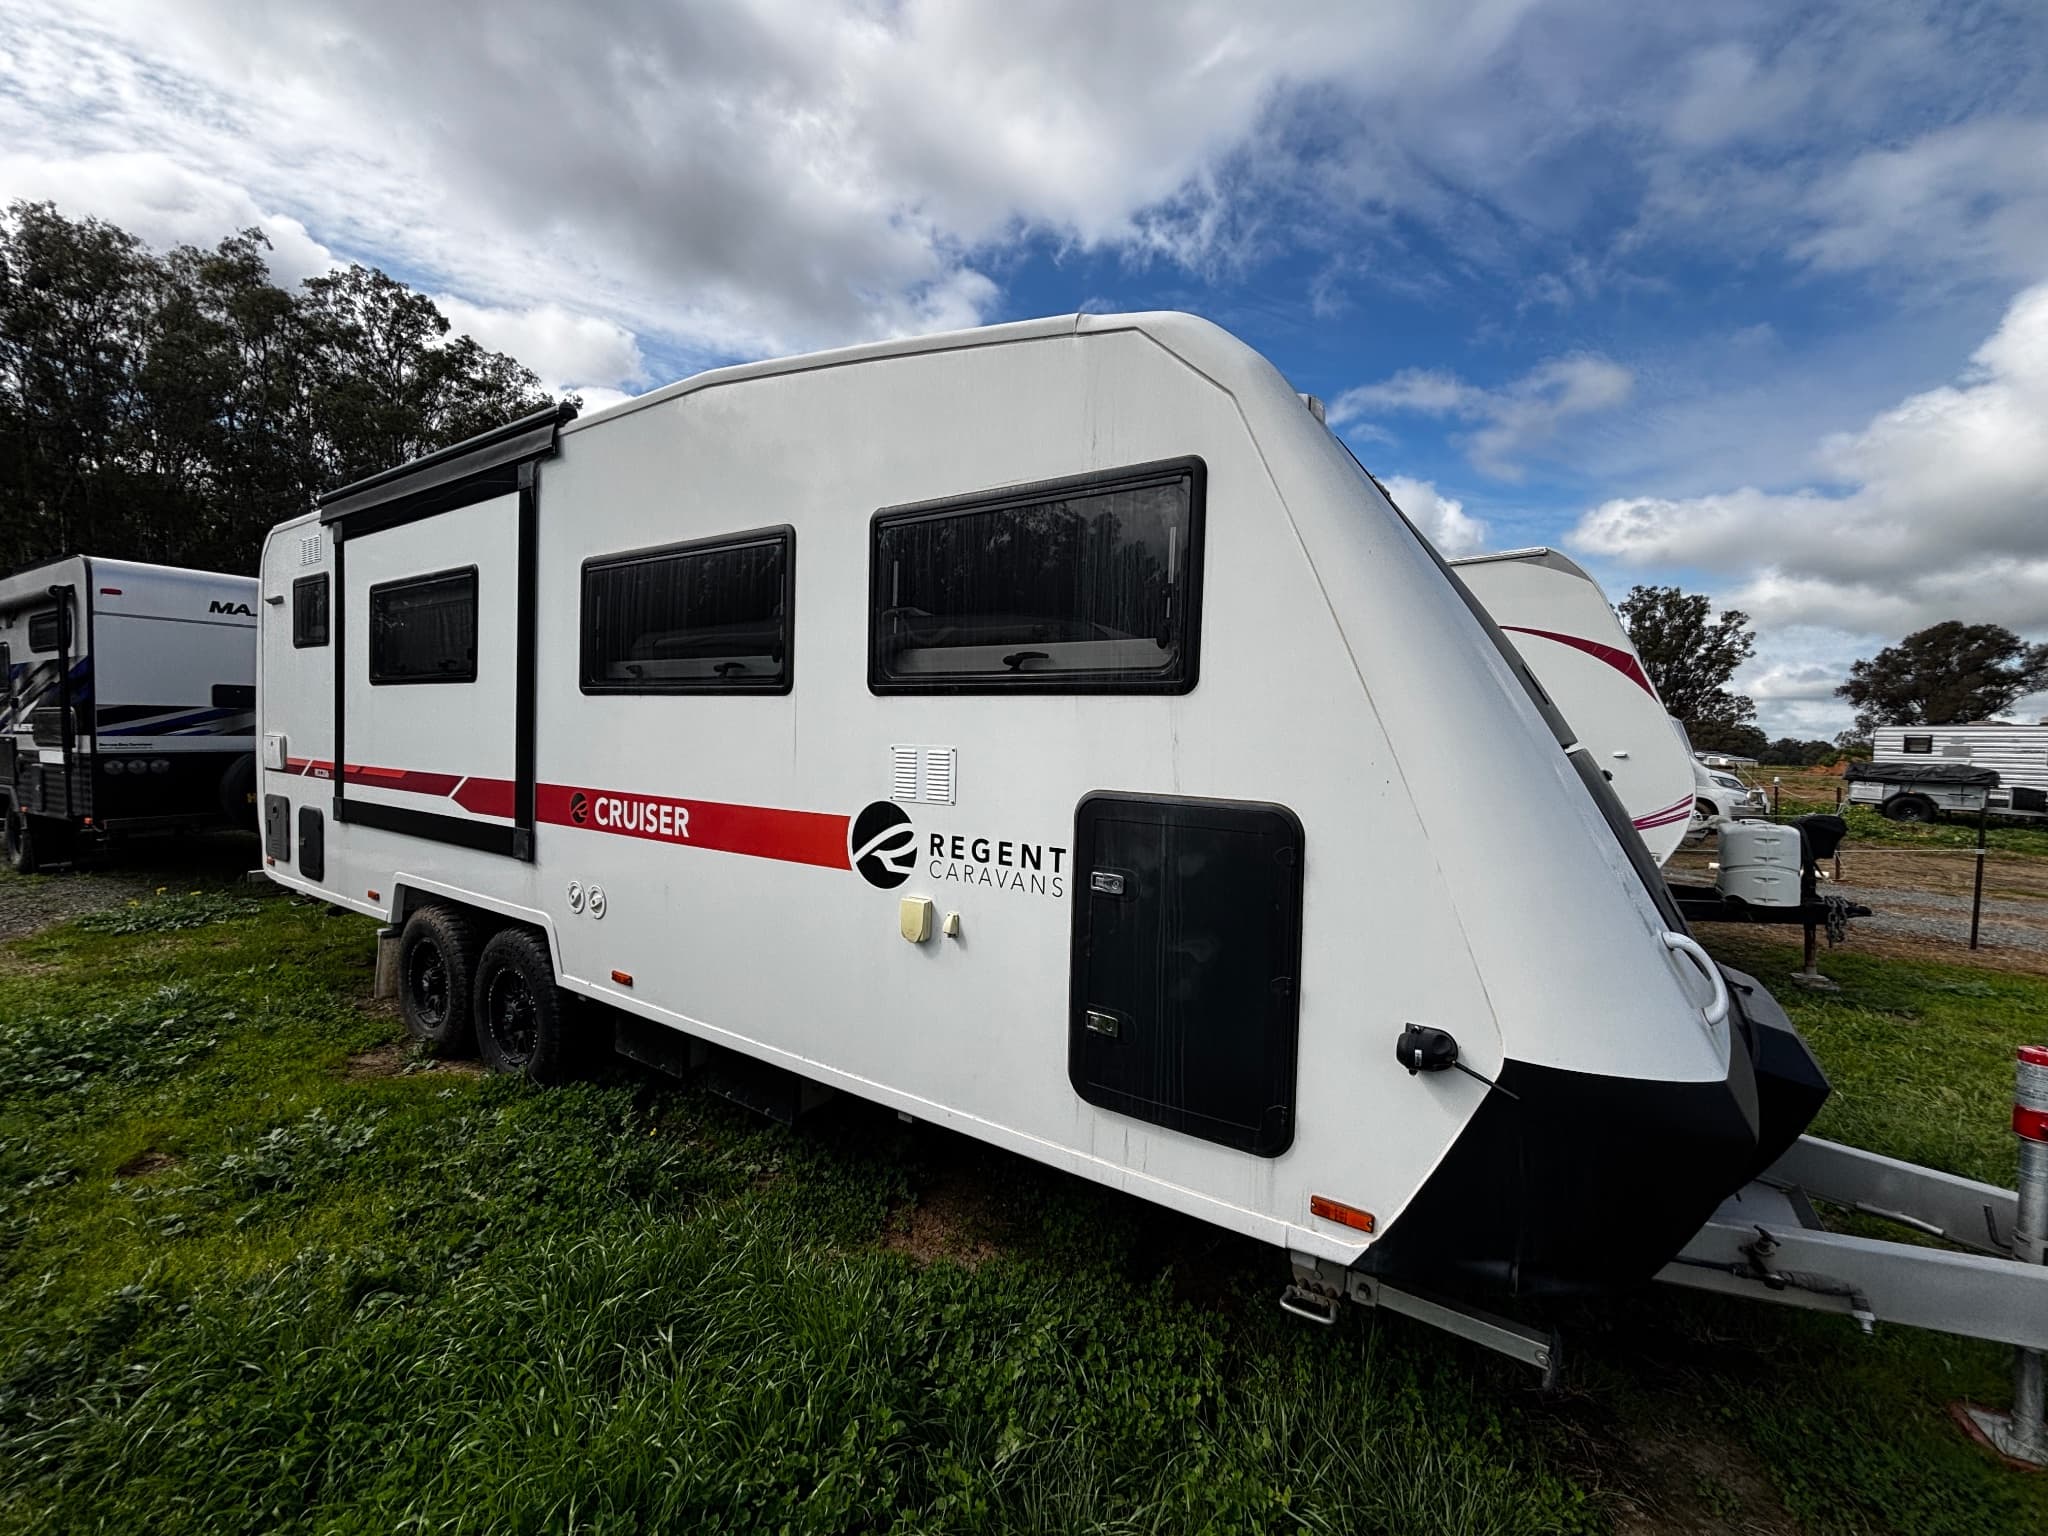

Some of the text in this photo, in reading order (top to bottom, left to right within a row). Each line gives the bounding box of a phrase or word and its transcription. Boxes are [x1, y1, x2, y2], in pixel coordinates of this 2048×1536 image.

[209, 600, 257, 617] MA
[594, 796, 690, 838] CRUISER
[929, 833, 1067, 873] REGENT
[929, 860, 1064, 898] CARAVANS
